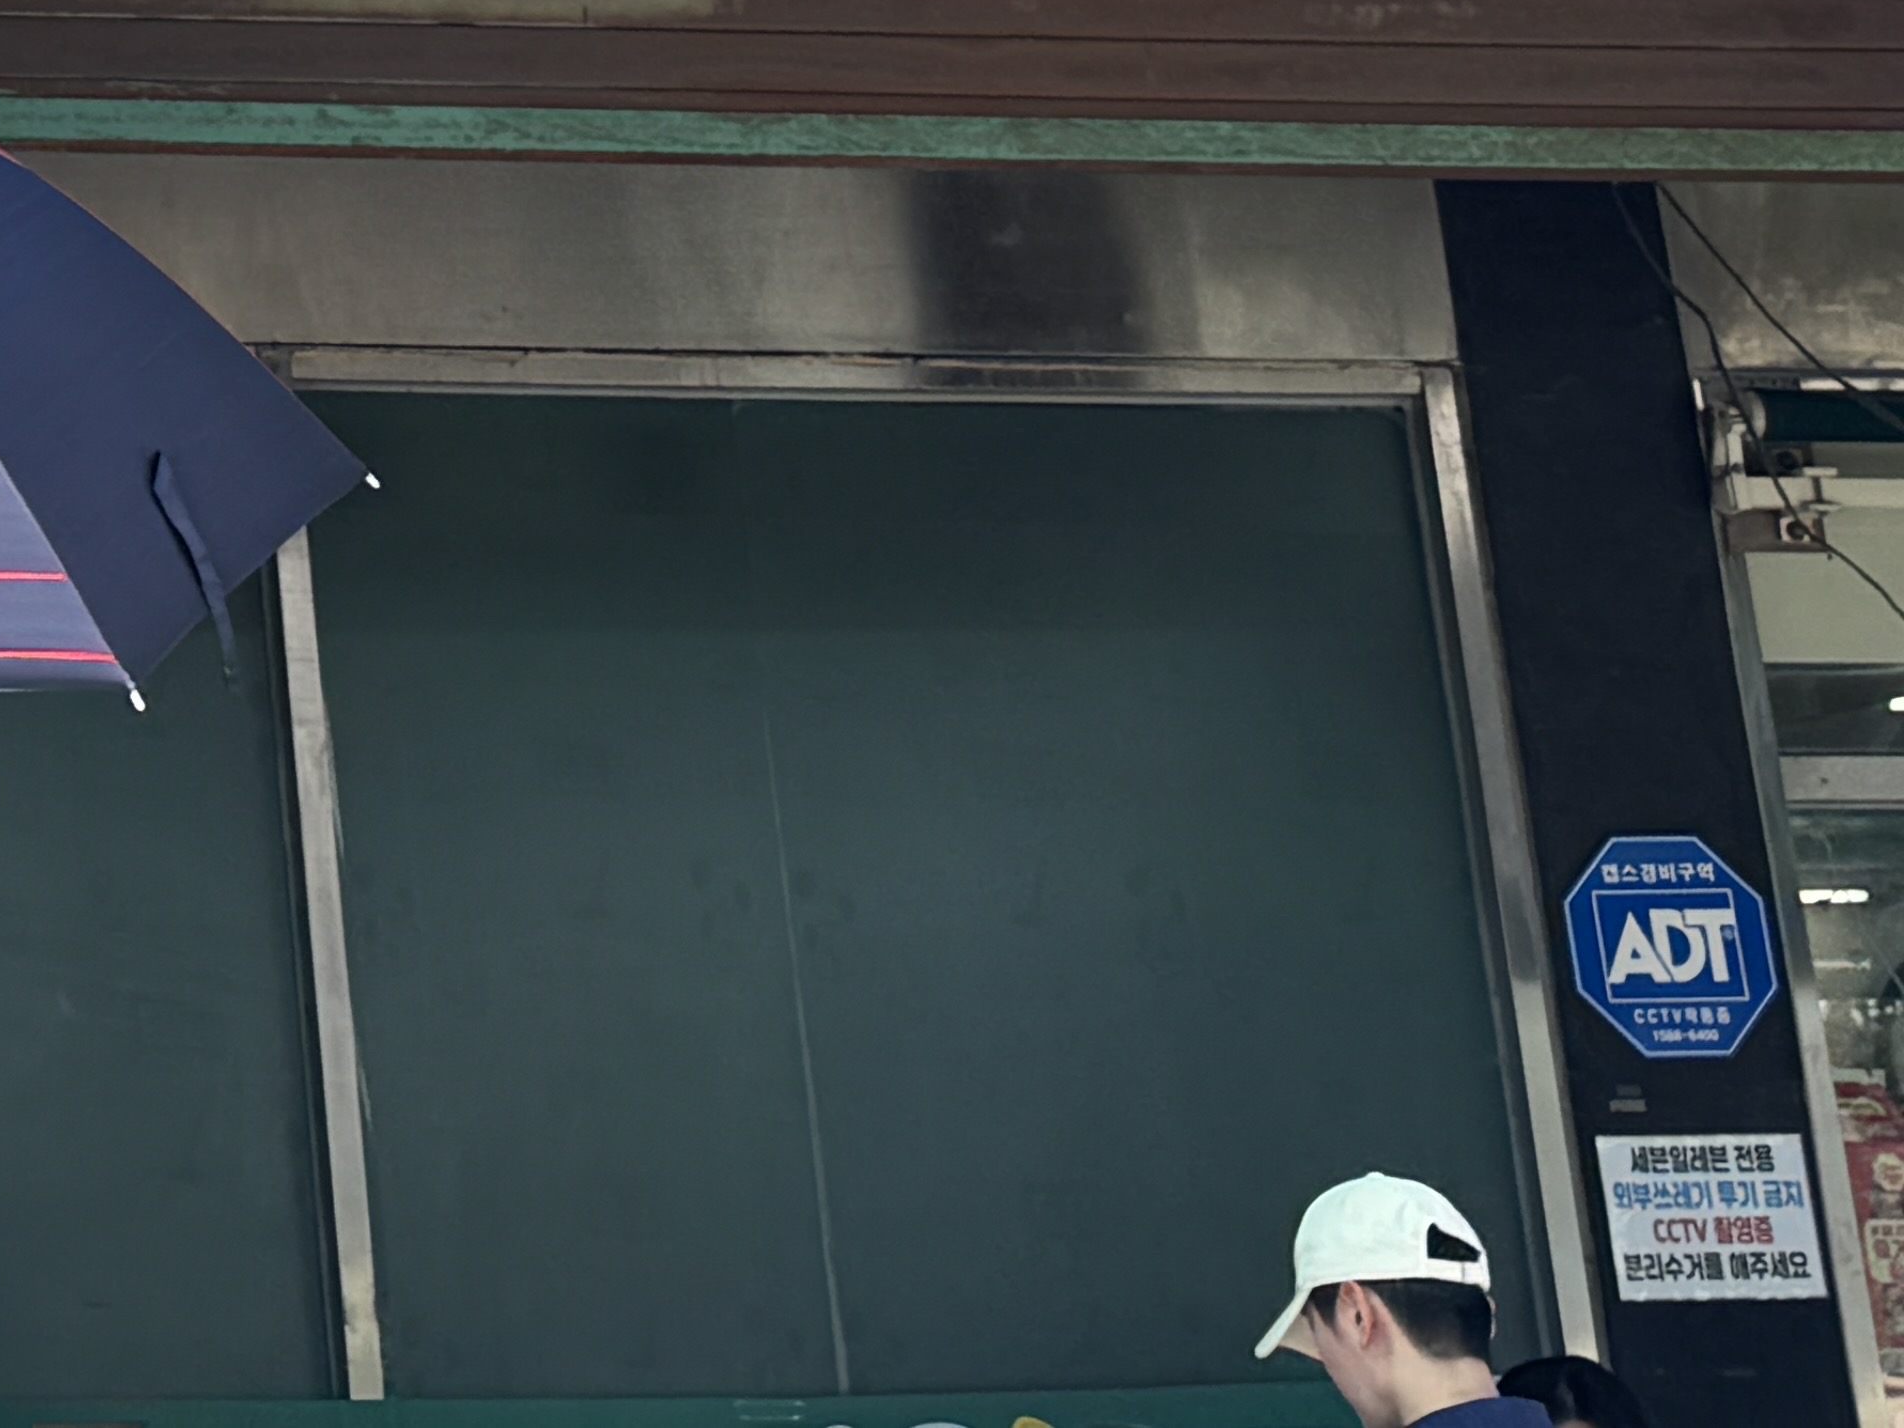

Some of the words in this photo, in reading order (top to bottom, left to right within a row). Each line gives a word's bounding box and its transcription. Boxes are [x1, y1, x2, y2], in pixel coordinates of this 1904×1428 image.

[1607, 908, 1737, 985] ADT
[1734, 1144, 1776, 1174] 전용
[1762, 1179, 1806, 1209] 금지
[1652, 1217, 1708, 1244] CCTV
